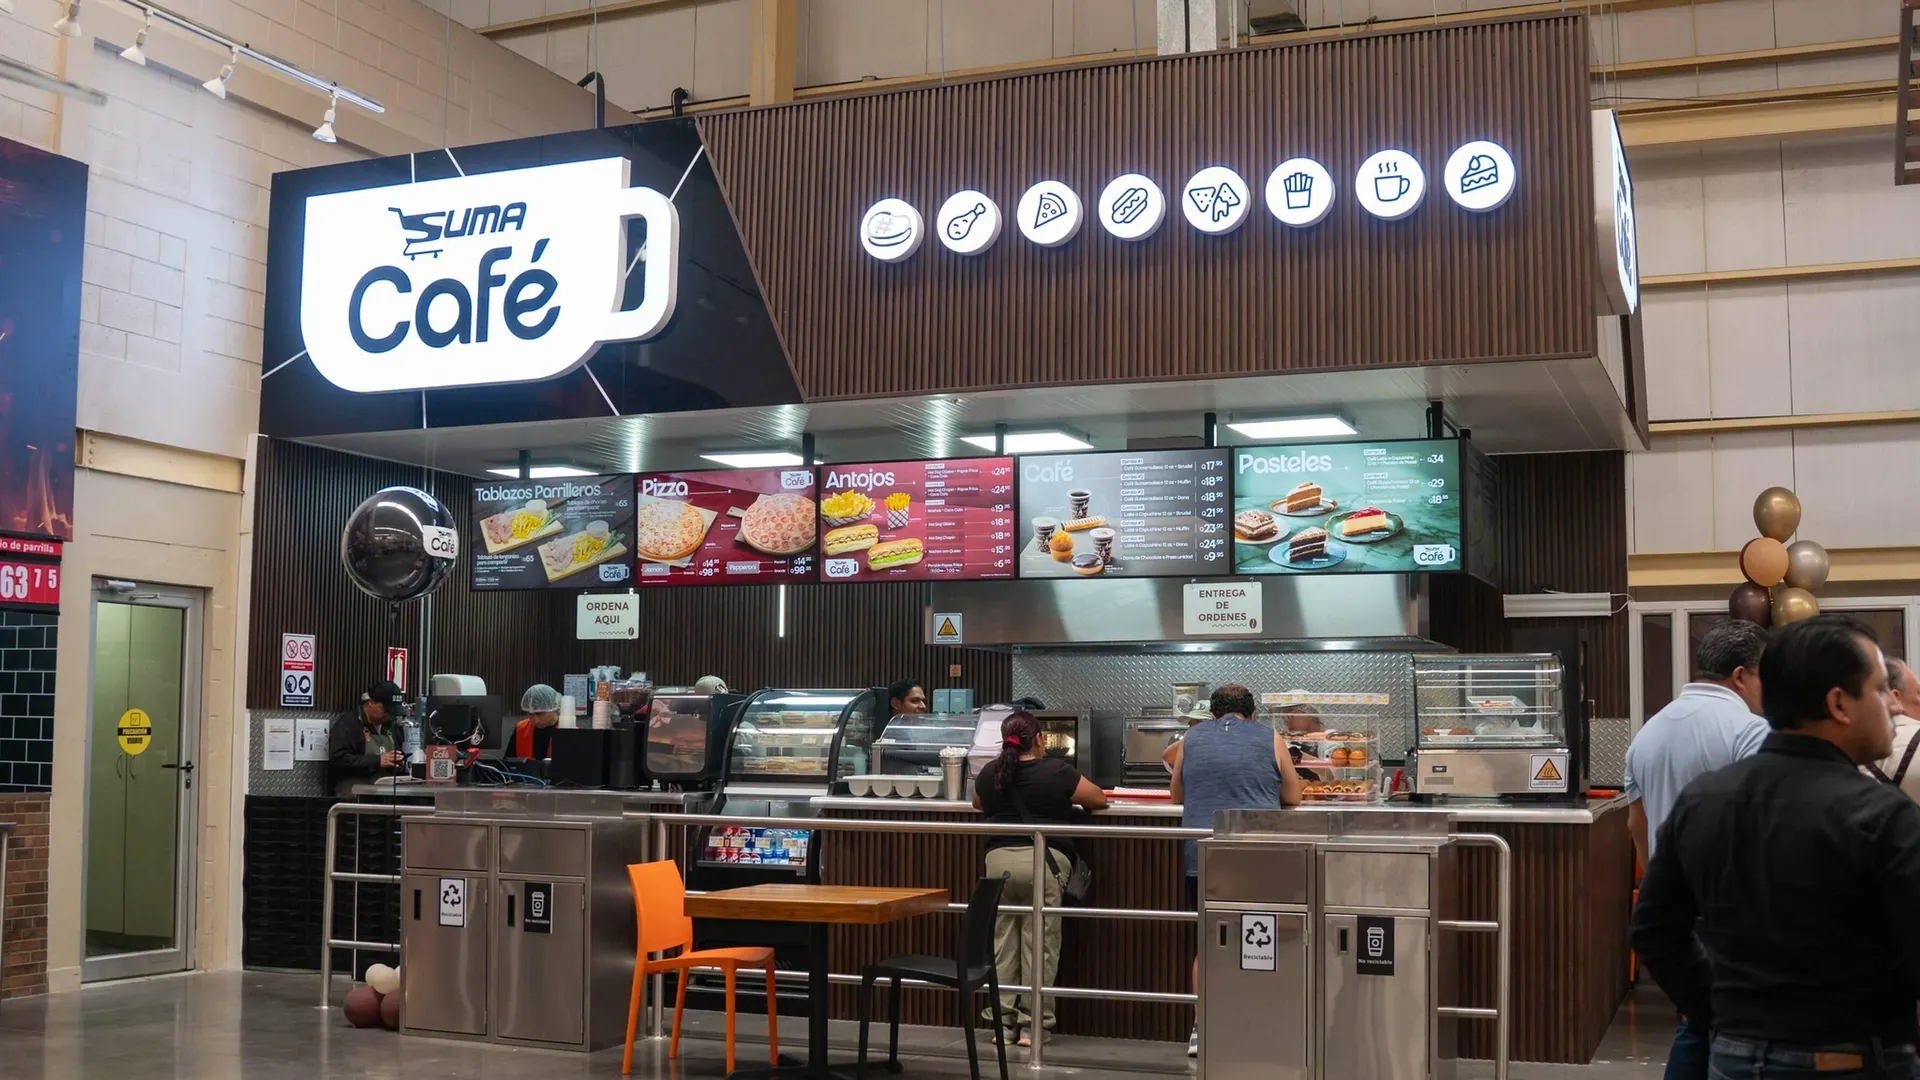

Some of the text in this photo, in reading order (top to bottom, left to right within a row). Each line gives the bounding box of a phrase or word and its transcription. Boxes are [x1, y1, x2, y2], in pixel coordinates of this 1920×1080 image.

[397, 202, 527, 249] SUMA
[349, 238, 561, 354] Café
[1239, 450, 1332, 474] Pasteles
[1427, 454, 1444, 463] Q34
[1200, 460, 1223, 470] Q17.95
[1024, 460, 1074, 483] Café
[785, 476, 804, 486] Café
[825, 468, 895, 492] Antojos
[1200, 475, 1223, 486] Q18.95
[1428, 479, 1444, 487] Q29
[475, 482, 600, 502] Tablazos Parrilleros
[642, 478, 689, 496] Pizza
[1200, 491, 1223, 502] Q18.95
[1201, 508, 1223, 517] Q21.95
[1199, 522, 1223, 533] Q23.95
[10, 540, 21, 550] de
[23, 543, 54, 553] parrilla
[1199, 538, 1223, 549] Q24.95
[1203, 551, 1224, 562] Q9.95
[1420, 551, 1444, 561] Café
[604, 569, 621, 578] Café
[830, 565, 850, 574] Café
[0, 565, 28, 598] 63
[1199, 589, 1246, 598] ENTREGA
[586, 601, 629, 611] ORDENA
[1216, 601, 1229, 609] DE
[595, 615, 620, 625] AQUI
[1198, 612, 1247, 621] ORDENES
